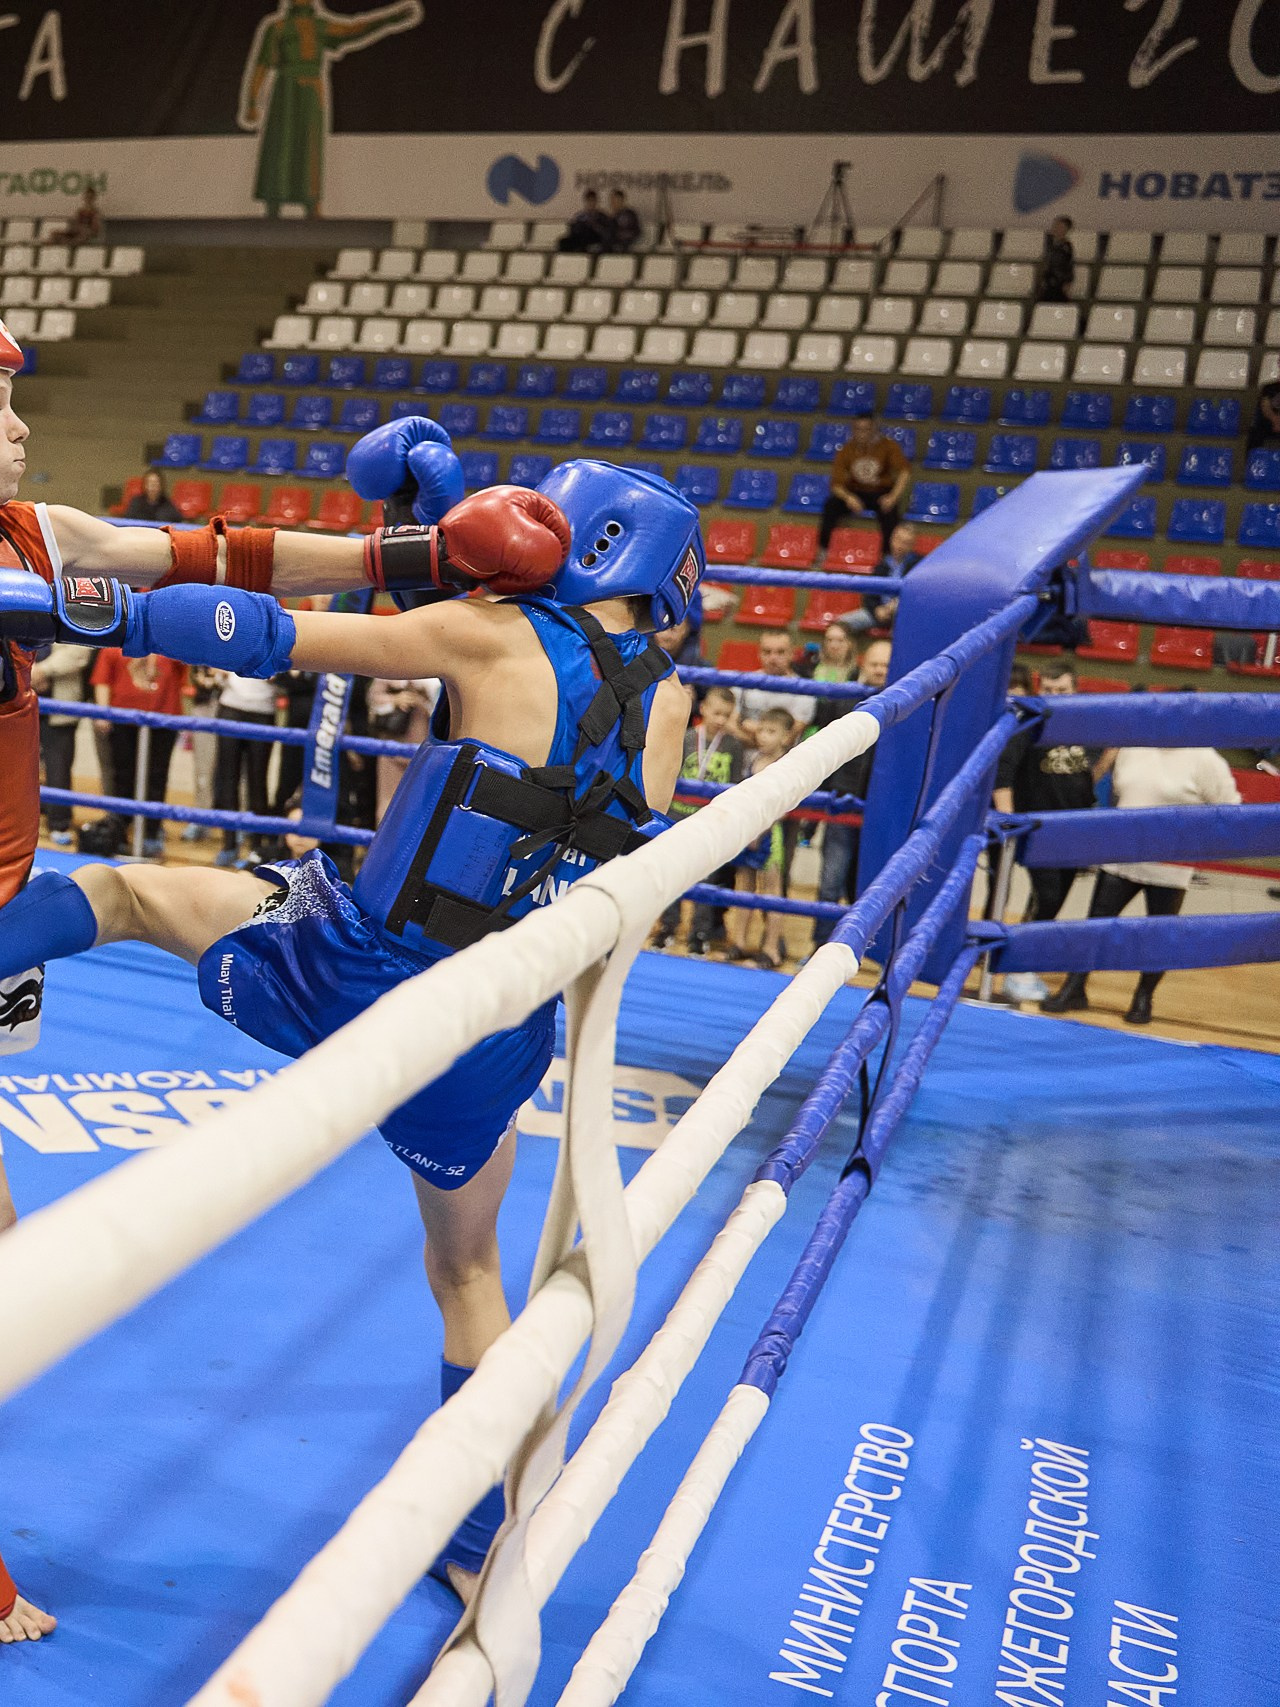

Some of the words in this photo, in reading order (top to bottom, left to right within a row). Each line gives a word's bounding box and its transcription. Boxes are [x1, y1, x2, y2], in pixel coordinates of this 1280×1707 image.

[310, 672, 348, 789] Emerald
[217, 953, 234, 984] Muay
[221, 987, 236, 1016] Thai
[768, 1422, 915, 1698] МИНИСТЕРСТВО
